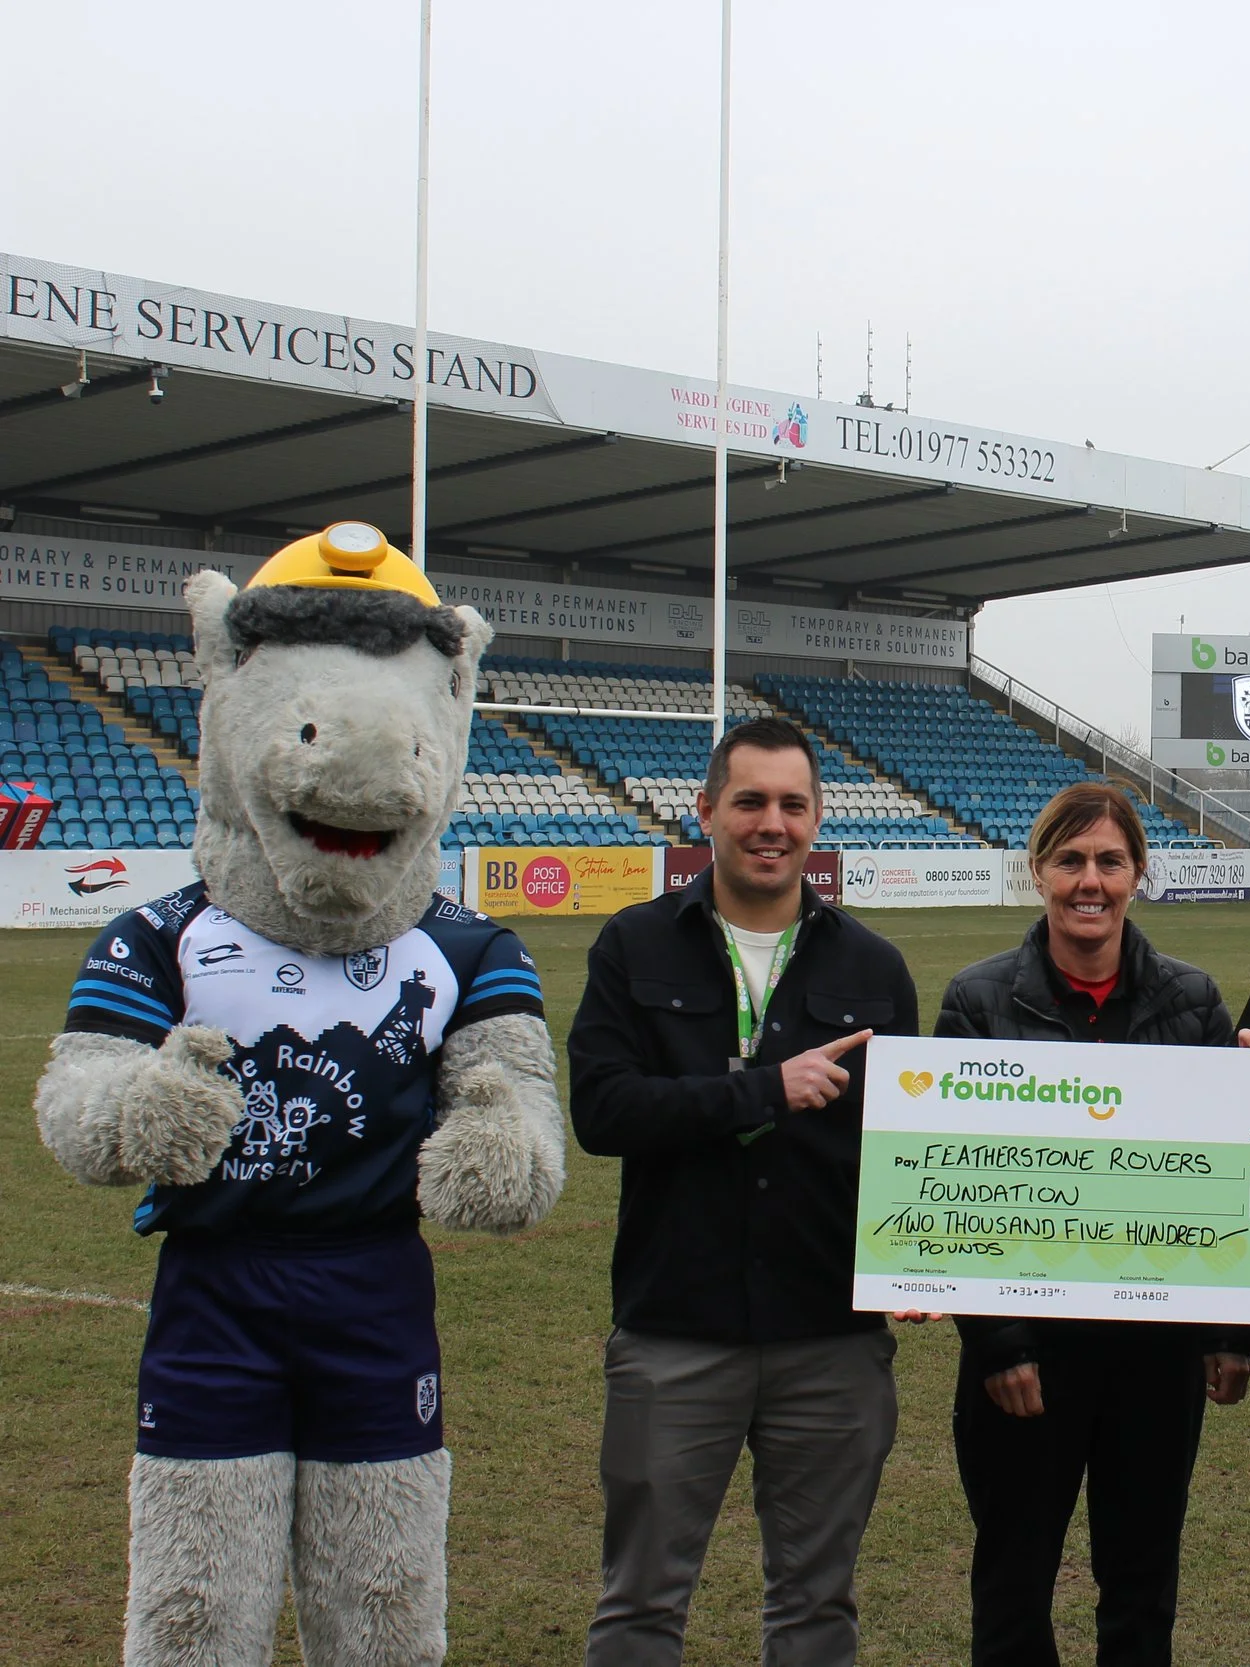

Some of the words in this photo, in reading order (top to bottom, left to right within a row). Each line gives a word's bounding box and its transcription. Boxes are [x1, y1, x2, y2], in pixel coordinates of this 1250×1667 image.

[137, 299, 376, 375] SERVICES
[393, 343, 537, 398] STAND
[671, 388, 709, 408] WARD
[677, 413, 740, 434] SERVIES
[744, 424, 767, 438] LTD
[836, 416, 969, 469] TEL:01977
[977, 441, 1055, 483] 553322
[83, 553, 94, 569] &
[534, 593, 543, 606] &
[552, 594, 648, 616] PERMANENT
[668, 603, 703, 621] DJL
[548, 613, 635, 633] SOLUTIONS
[738, 610, 771, 626] DJL
[677, 630, 694, 638] LTD
[791, 616, 869, 634] TEMPORARY
[876, 625, 883, 635] &
[890, 625, 964, 642] PERMANENT
[806, 634, 881, 651] PERIMETER
[887, 641, 956, 658] SOLUTIONS
[16, 809, 43, 850] BET
[487, 861, 518, 890] BB
[533, 867, 561, 879] POST
[575, 856, 615, 878] Station
[622, 858, 648, 878] Lane
[926, 871, 949, 881] 0800
[951, 870, 973, 881] 5200
[975, 870, 991, 881] 555
[1006, 861, 1026, 872] THE
[1179, 865, 1208, 885] 01977
[1209, 865, 1226, 885] 329
[1228, 864, 1245, 884] 189
[847, 868, 875, 887] 24/7
[526, 882, 565, 895] OFFICE
[881, 889, 892, 897] Our
[894, 889, 907, 897] solid
[908, 889, 938, 898] reputation
[945, 889, 956, 898] your
[22, 902, 45, 917] PFI
[50, 906, 100, 916] Mechanical
[484, 899, 519, 908] Superstore
[86, 957, 154, 989] bartercard
[272, 985, 306, 995] RAVENSPORT
[960, 1059, 1024, 1077] moto
[277, 1045, 366, 1138] Rainbow
[939, 1072, 1122, 1105] foundation
[895, 1156, 918, 1170] Pay
[925, 1144, 1094, 1171] FEATHERSTONE
[1110, 1147, 1212, 1174] ROVERS
[222, 1158, 321, 1186] Nursery
[919, 1177, 1079, 1206] FOUNDATION
[894, 1207, 934, 1234] TWO
[943, 1211, 1055, 1240] THOUSAND
[1065, 1219, 1114, 1241] FIVE
[1127, 1222, 1217, 1247] HUNDRED
[918, 1239, 1004, 1256] POUNDS
[1113, 1290, 1169, 1301] 20148802
